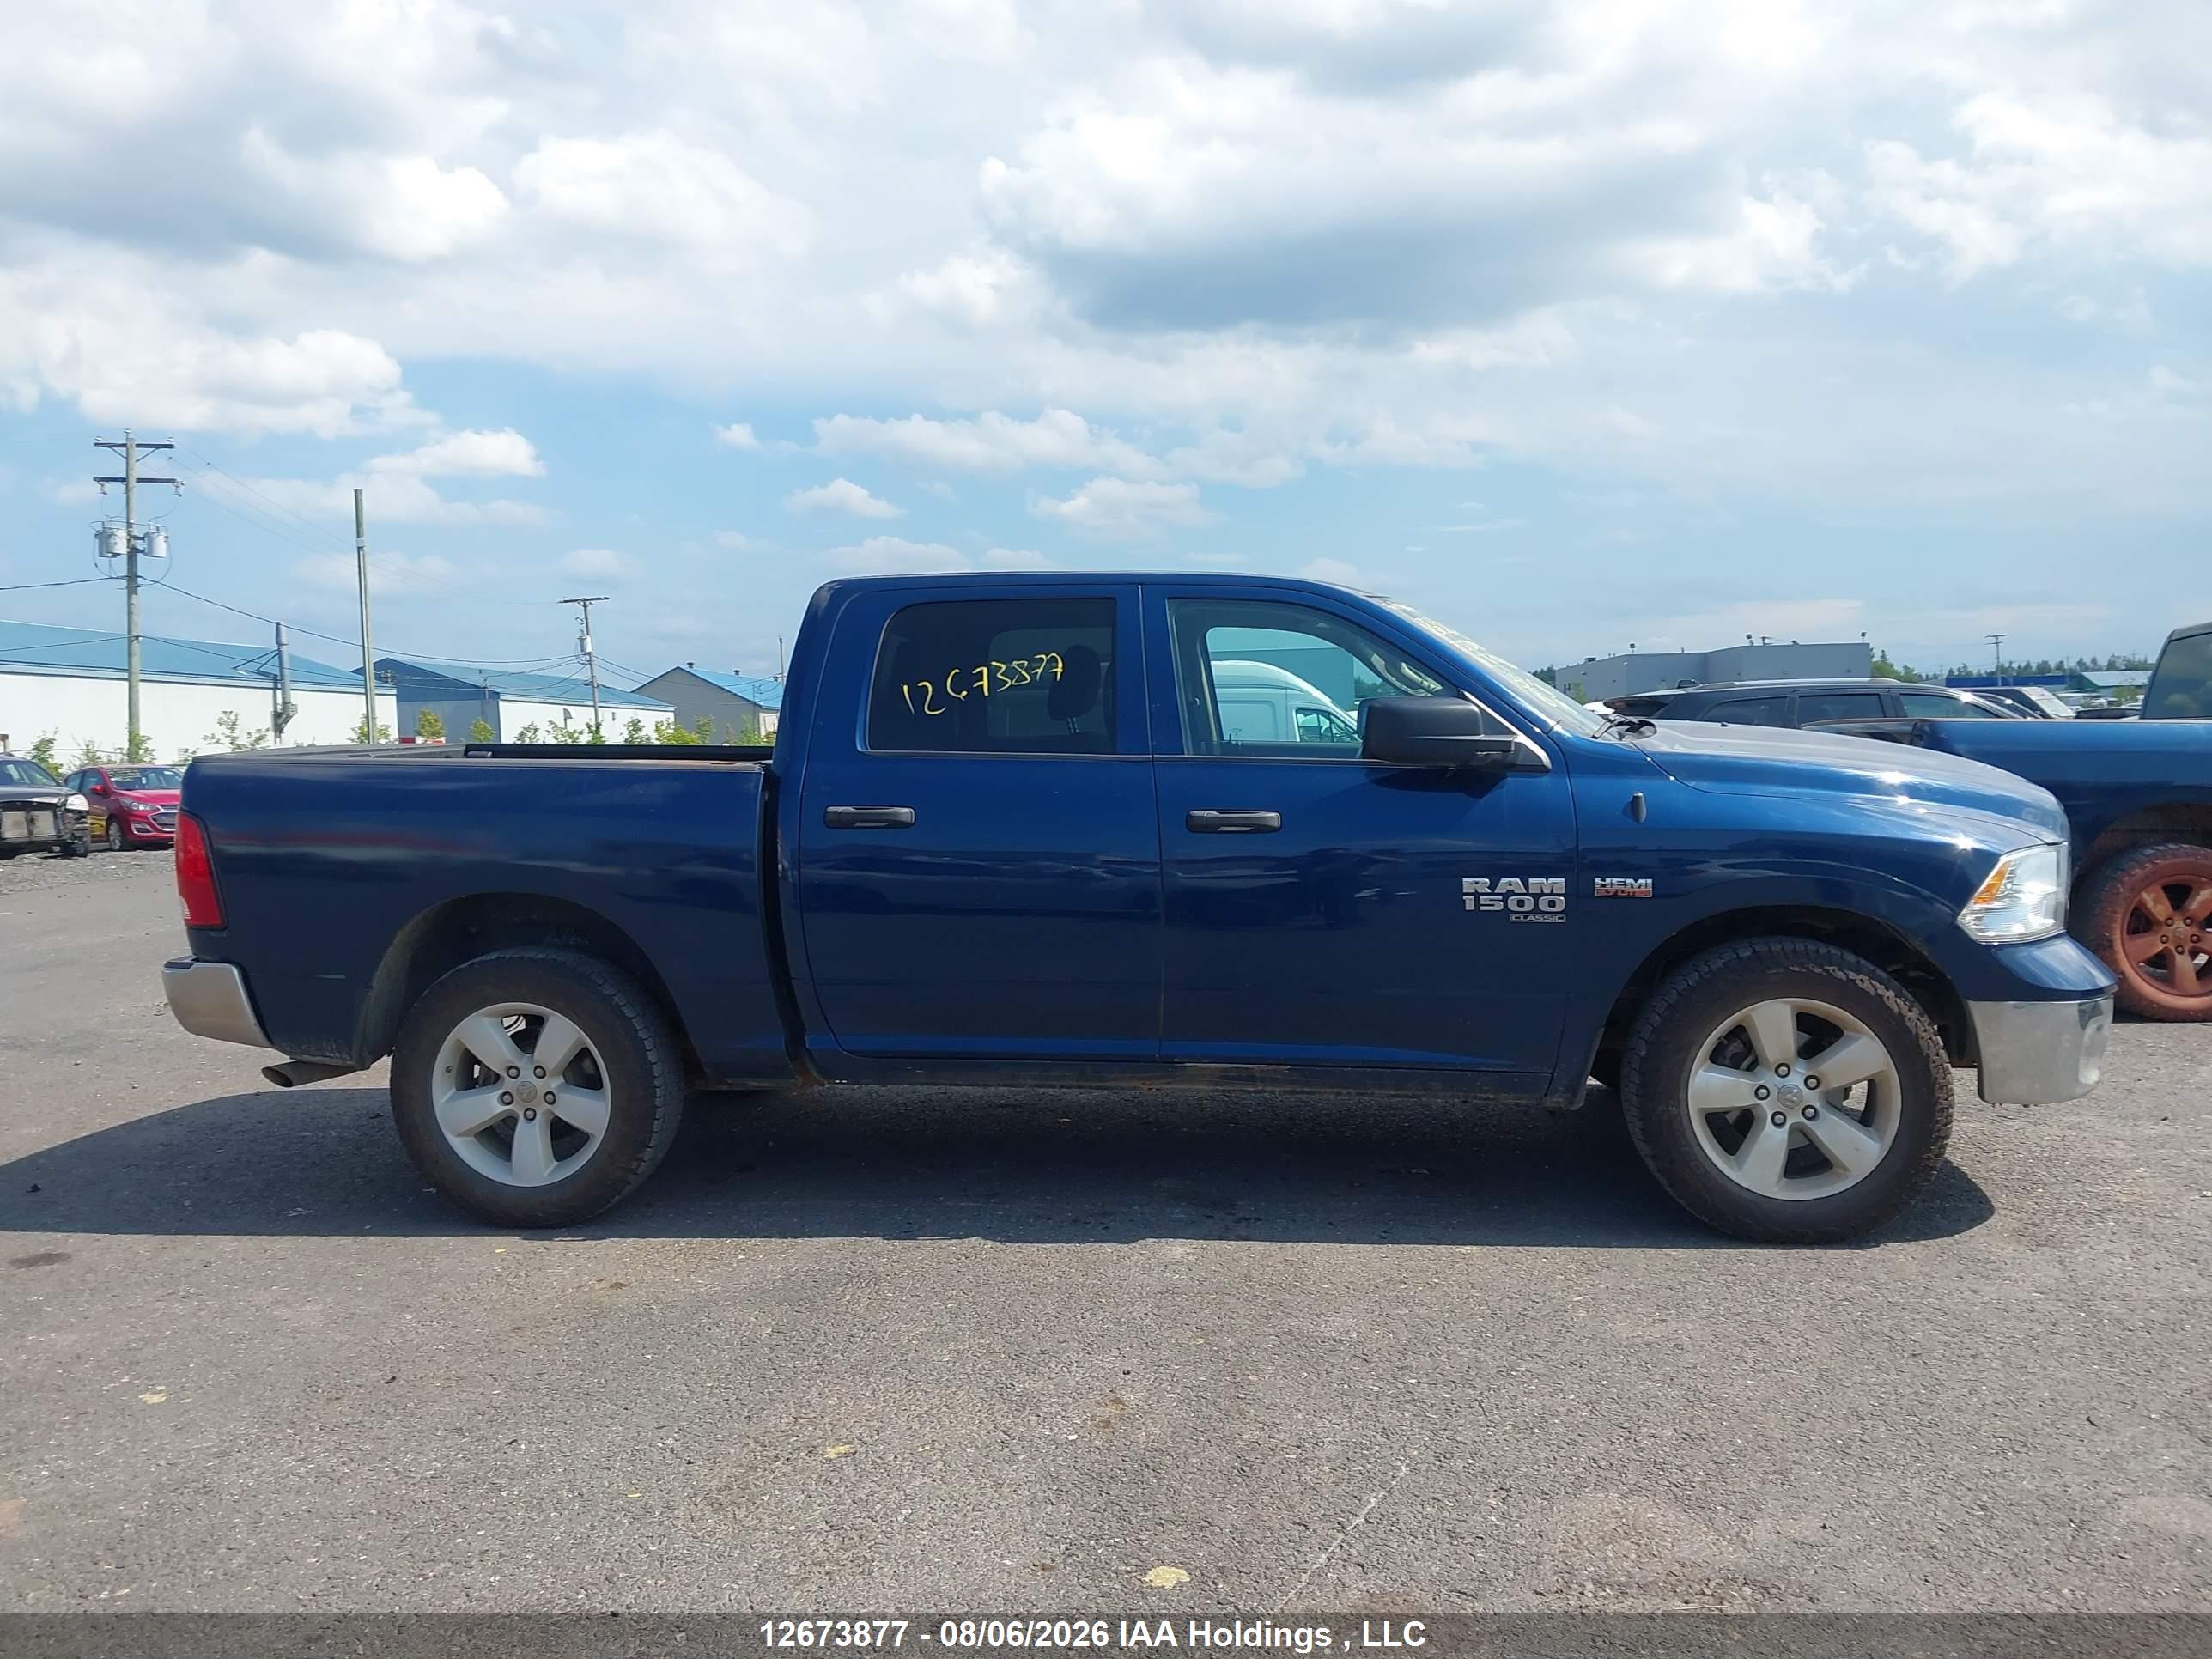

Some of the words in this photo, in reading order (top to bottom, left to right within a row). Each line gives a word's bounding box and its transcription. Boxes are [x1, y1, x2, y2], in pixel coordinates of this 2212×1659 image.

[1462, 877, 1565, 893] RAM
[1595, 878, 1653, 890] HEMI
[1462, 896, 1566, 912] 1500
